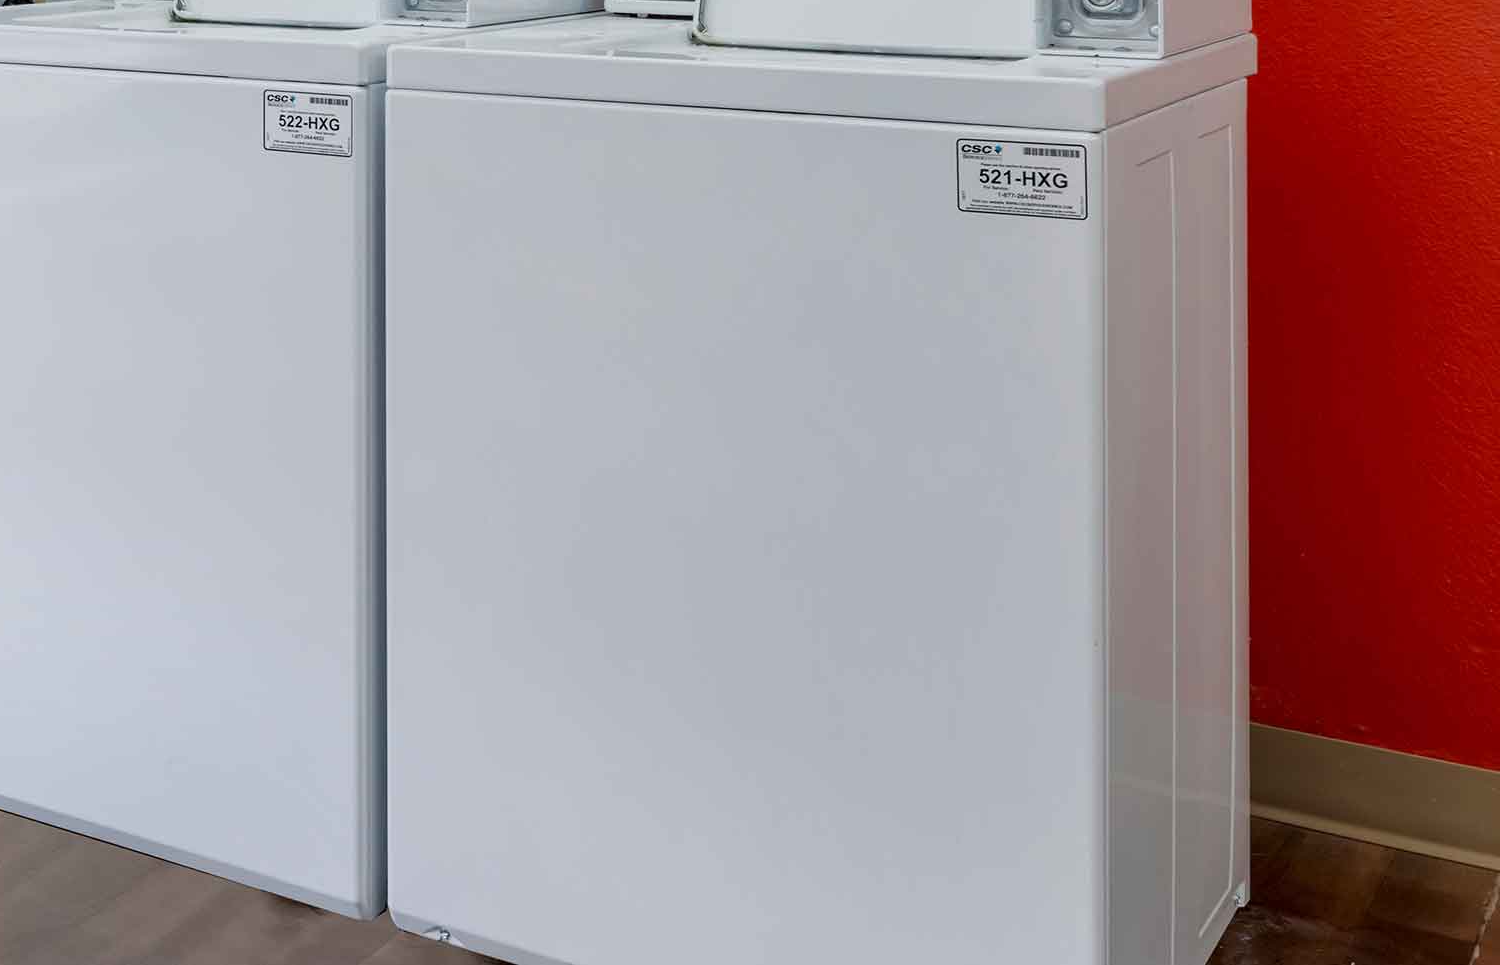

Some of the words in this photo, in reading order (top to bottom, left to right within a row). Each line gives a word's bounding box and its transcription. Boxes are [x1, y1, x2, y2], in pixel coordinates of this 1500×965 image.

[267, 94, 289, 102] CSC
[278, 114, 340, 131] 522-HXG
[961, 144, 993, 154] CSC
[979, 168, 1068, 189] 521-HXG
